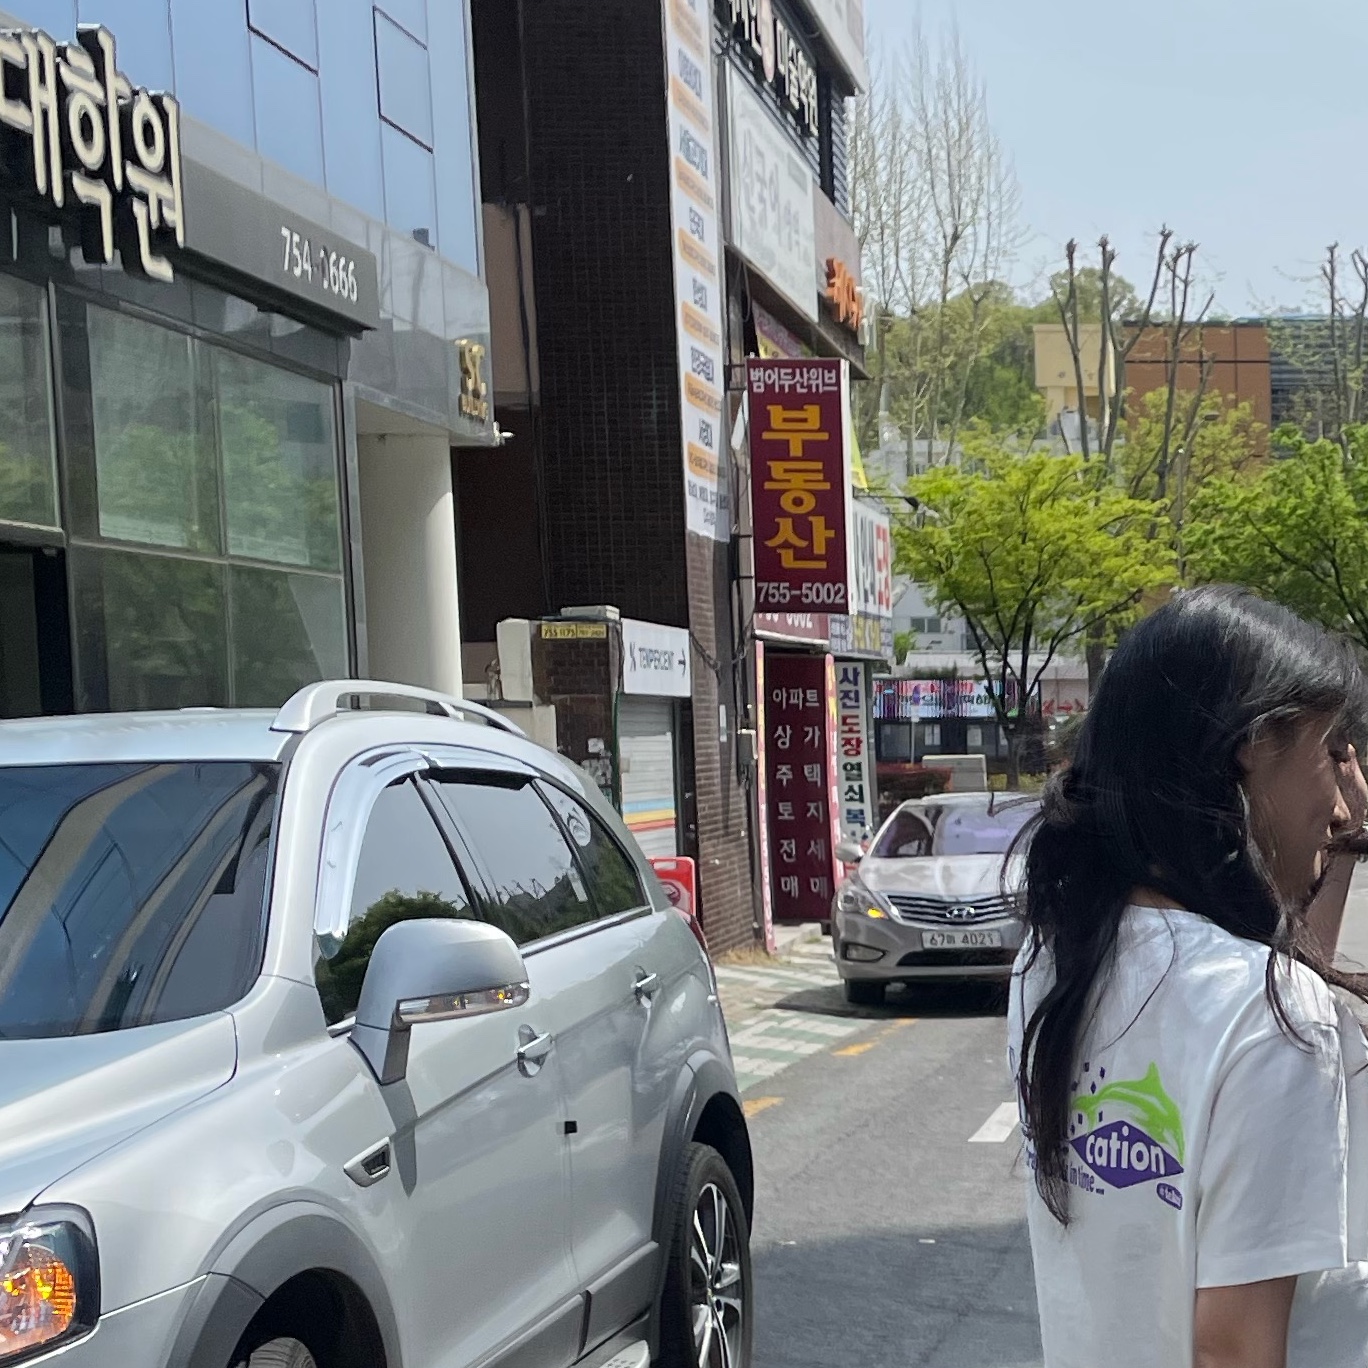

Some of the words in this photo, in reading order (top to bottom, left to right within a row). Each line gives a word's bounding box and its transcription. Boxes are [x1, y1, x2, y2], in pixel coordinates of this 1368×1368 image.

[0, 26, 185, 283] 대학원
[749, 366, 838, 394] 범어두산위브
[762, 404, 836, 569] 부동산
[757, 582, 846, 604] 755-5002
[772, 687, 820, 711] 아파트
[841, 715, 863, 757] 도장
[842, 762, 864, 804] 열쇠
[1085, 1125, 1166, 1176] cation
